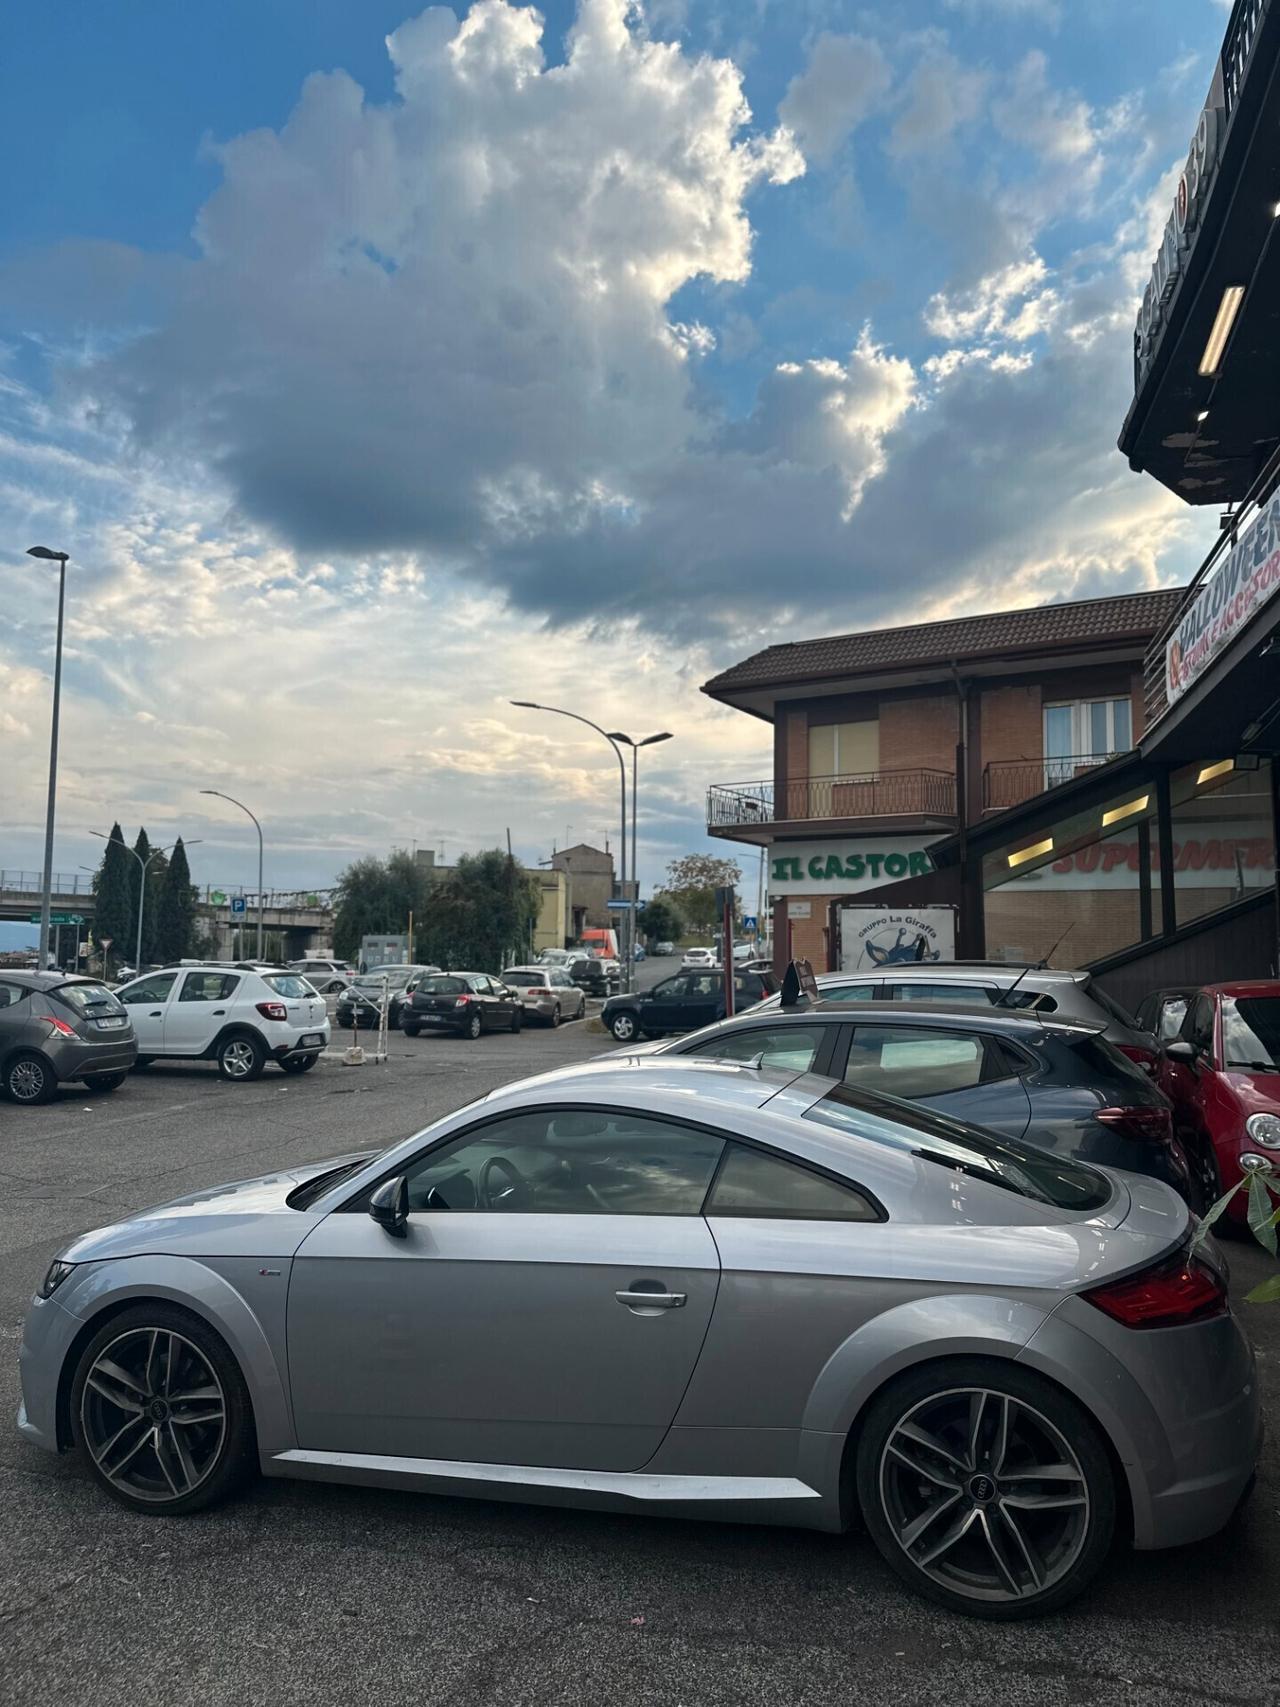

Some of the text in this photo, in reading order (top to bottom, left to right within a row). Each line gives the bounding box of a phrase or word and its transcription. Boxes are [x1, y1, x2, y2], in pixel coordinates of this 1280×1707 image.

[1179, 499, 1280, 661] HALLOWEEN
[772, 850, 933, 881] IL CASTOR
[234, 900, 243, 912] P
[858, 915, 937, 939] GRUPPO La Giraffa
